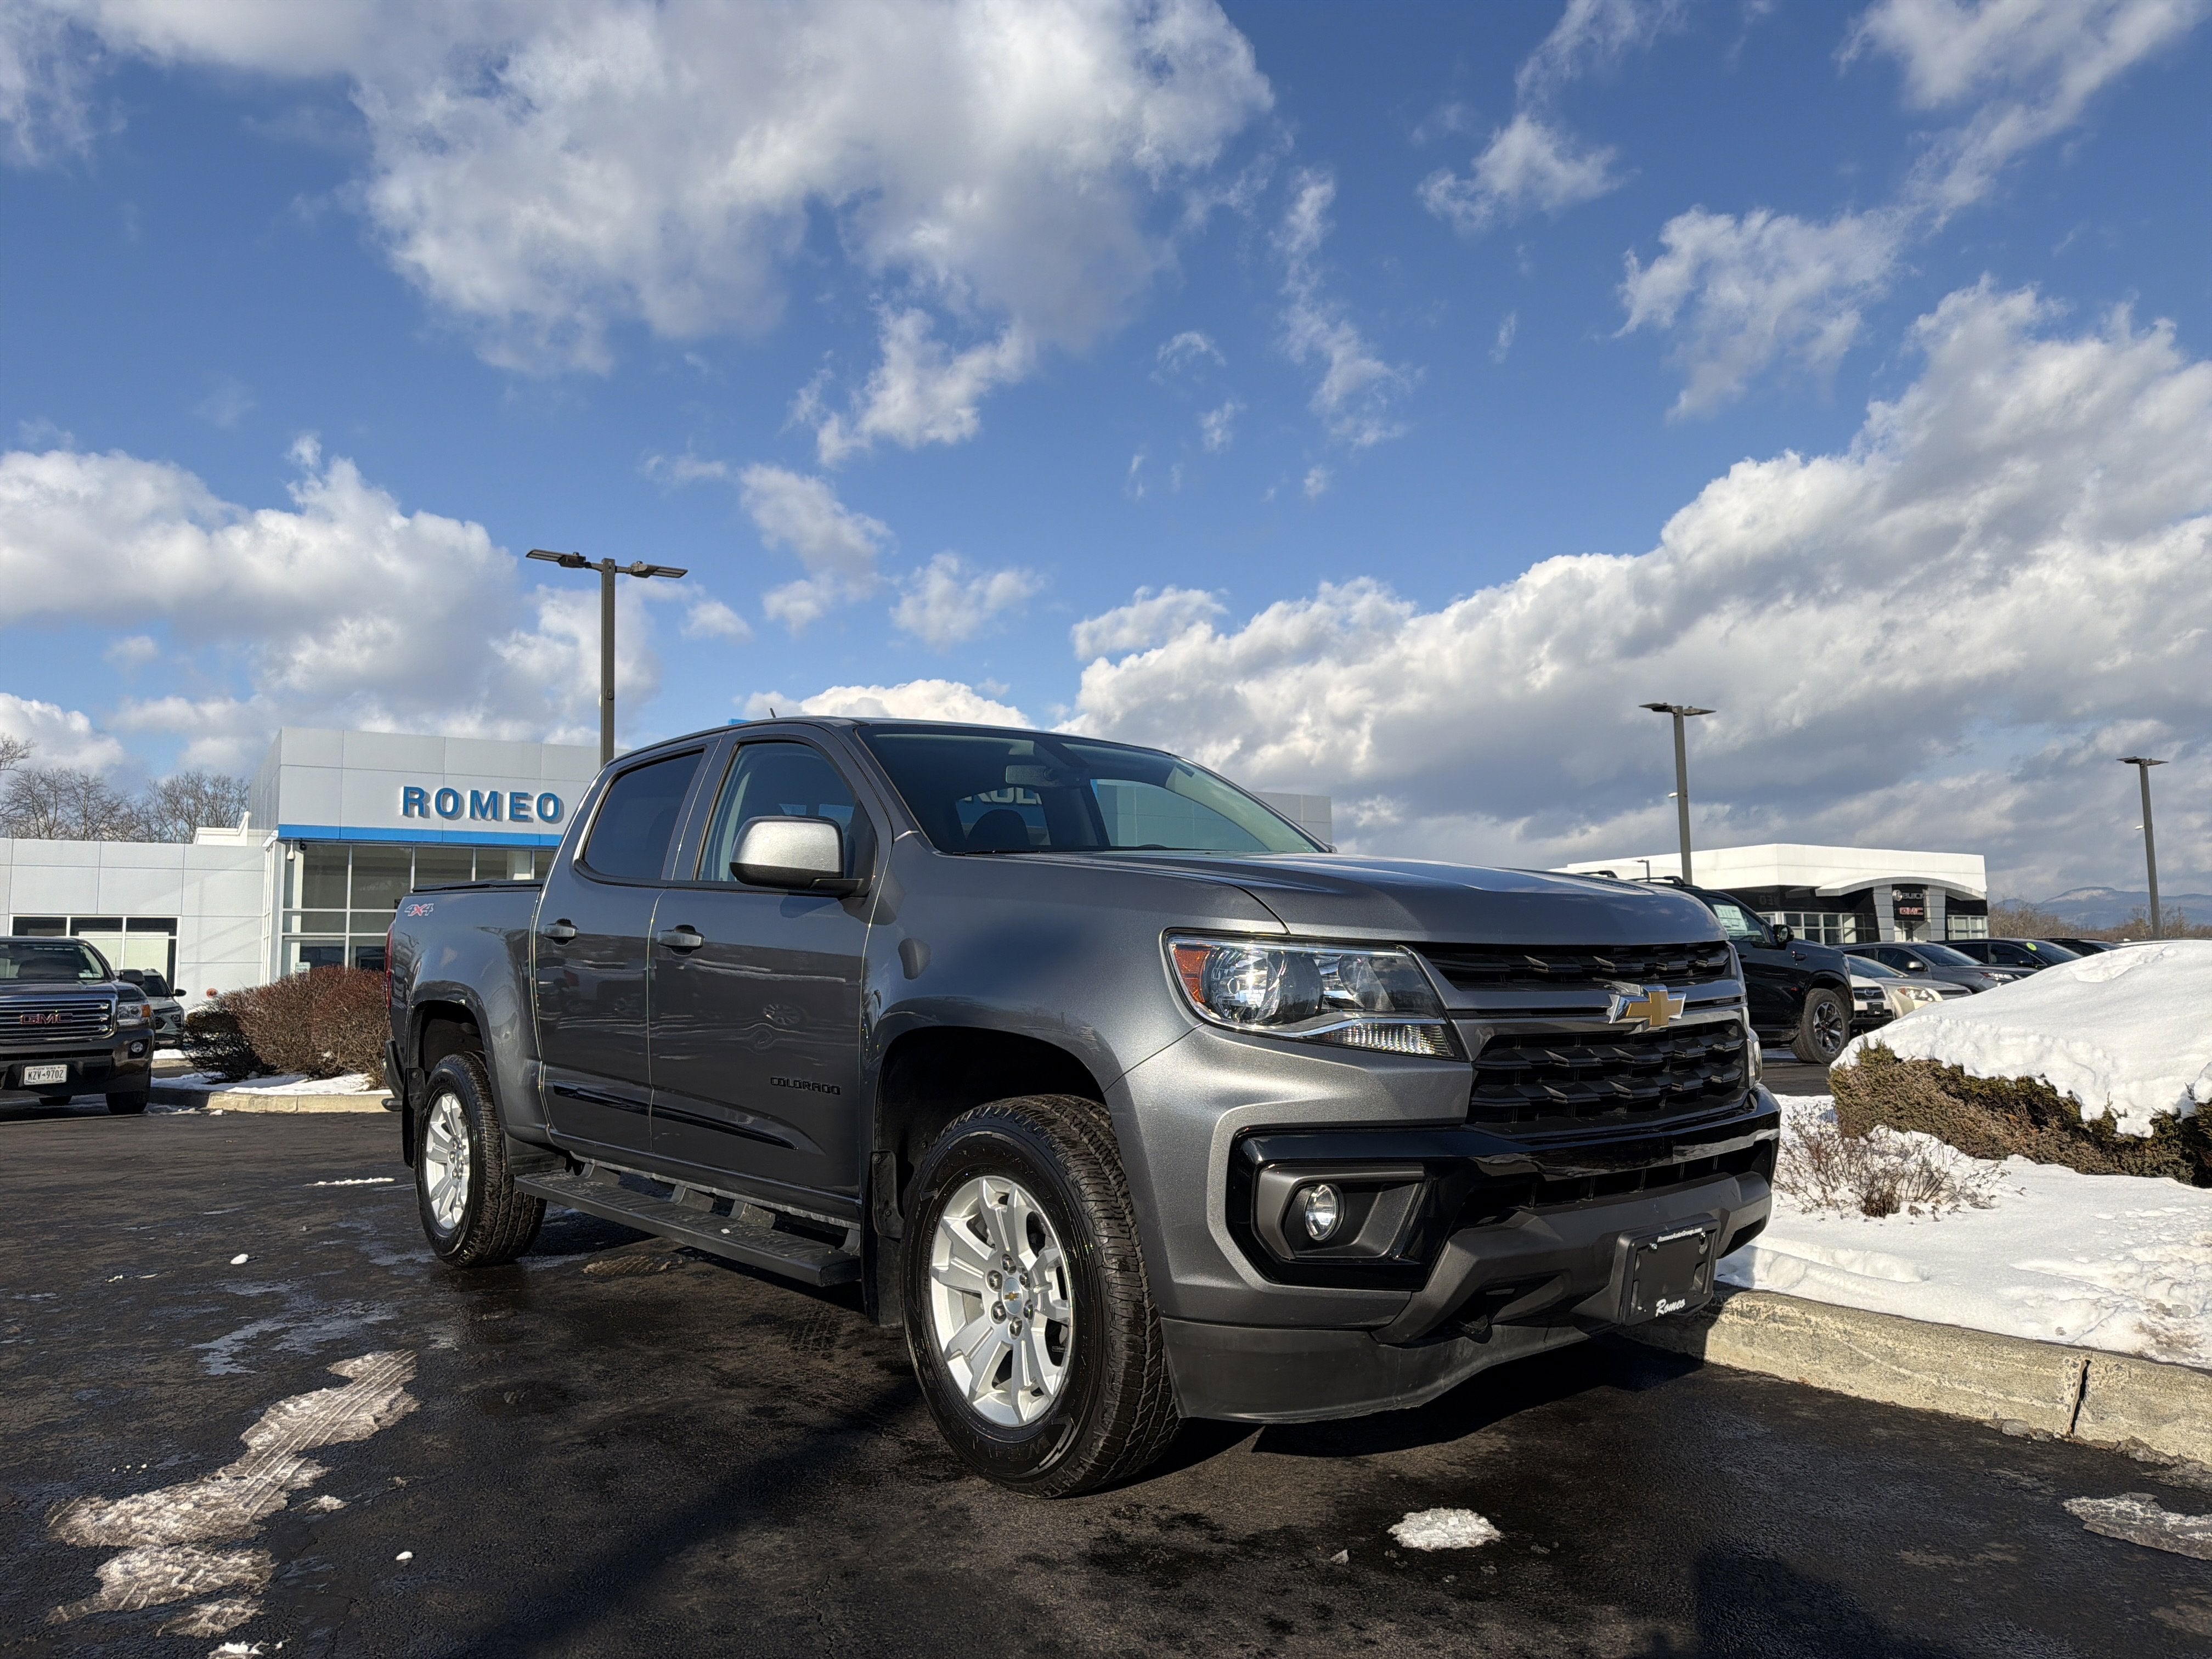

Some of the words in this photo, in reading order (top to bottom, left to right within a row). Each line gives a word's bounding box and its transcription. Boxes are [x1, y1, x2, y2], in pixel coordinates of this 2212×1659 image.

[402, 786, 561, 823] ROMEO
[1899, 907, 1923, 916] GMC
[20, 1013, 73, 1025] GMC
[770, 1077, 841, 1096] COLORADO
[1655, 1299, 1686, 1317] Romeo
